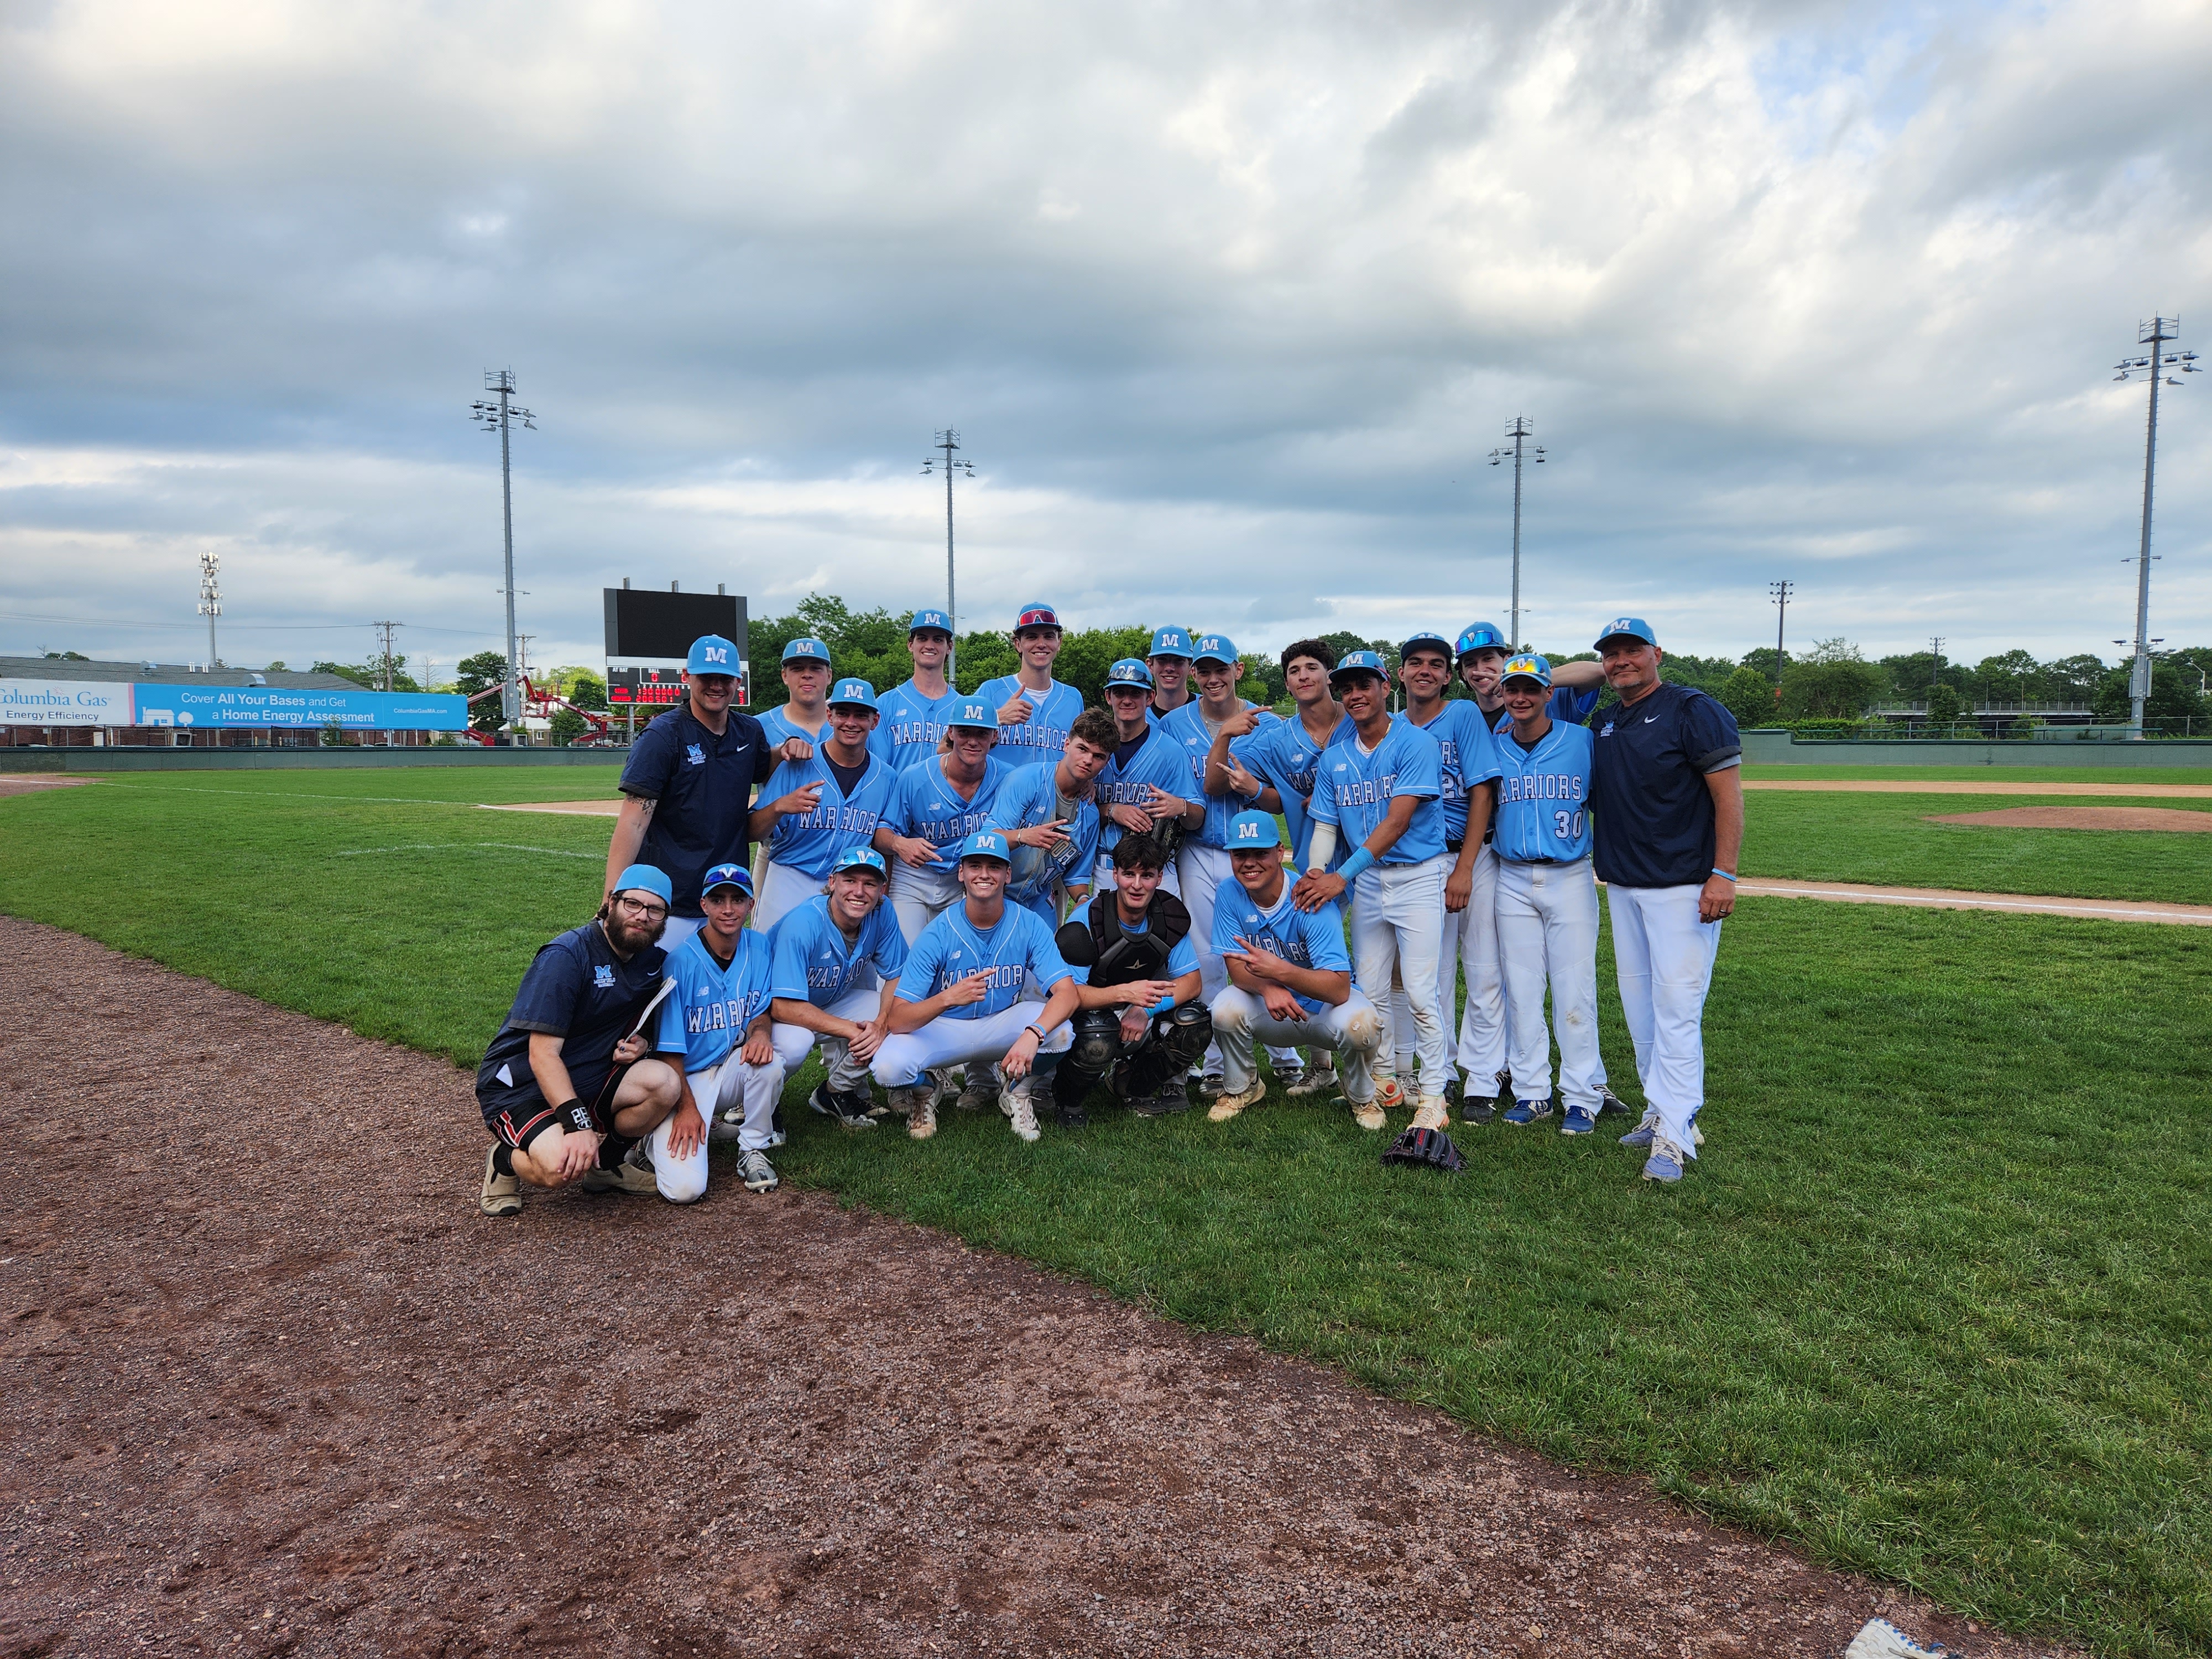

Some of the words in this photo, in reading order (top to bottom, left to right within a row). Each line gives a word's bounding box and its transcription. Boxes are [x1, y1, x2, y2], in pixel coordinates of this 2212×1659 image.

[924, 613, 941, 625] M
[1609, 619, 1631, 633] M
[1162, 634, 1179, 647] M
[1201, 638, 1219, 653] M
[705, 646, 728, 664] M
[796, 642, 815, 654] M
[1344, 654, 1364, 667] M
[77, 691, 107, 706] Gas
[843, 684, 864, 700] M
[181, 693, 215, 703] Cover
[218, 693, 234, 704] All
[237, 693, 267, 705] Your
[269, 695, 305, 706] Bases
[309, 697, 326, 706] and
[329, 697, 346, 707] Get
[6, 711, 44, 721] Energy
[48, 711, 99, 722] Efficiency
[223, 709, 259, 720] Home
[262, 710, 304, 723] Energy
[307, 711, 374, 722] Assessment
[963, 705, 983, 721] M
[1238, 822, 1259, 839] M
[1554, 810, 1583, 839] 30
[975, 835, 996, 850] M
